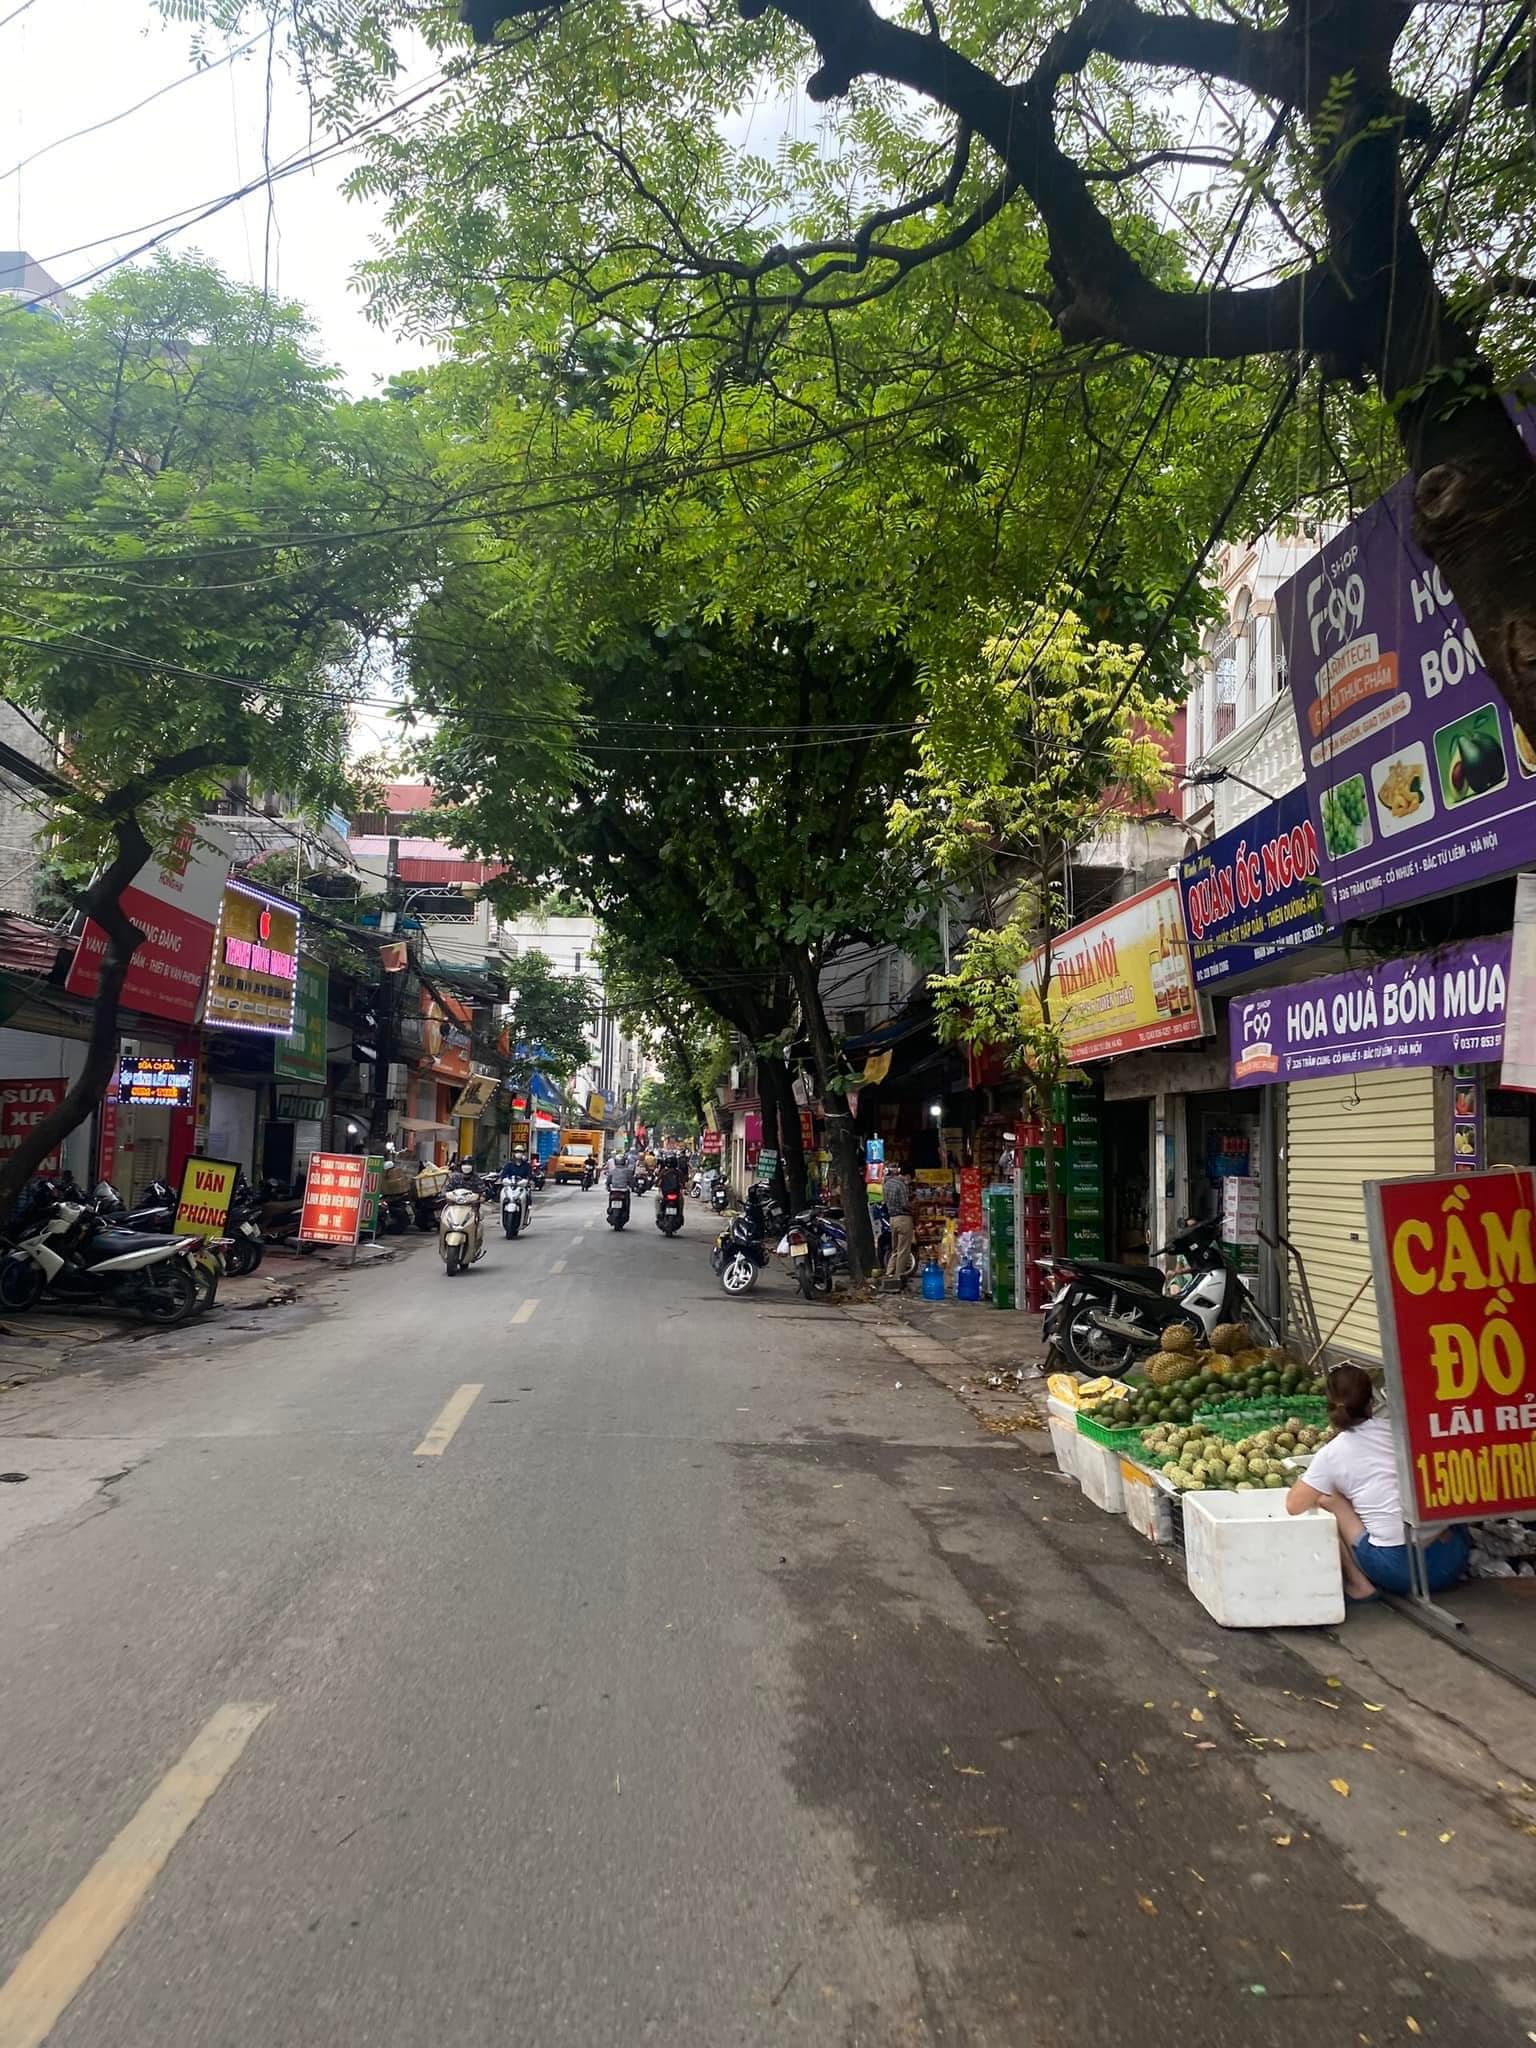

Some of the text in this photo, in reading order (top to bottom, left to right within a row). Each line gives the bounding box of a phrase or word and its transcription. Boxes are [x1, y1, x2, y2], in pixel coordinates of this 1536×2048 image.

[1330, 545, 1358, 579] SHOP
[1307, 573, 1365, 656] F99
[1410, 565, 1454, 624] HO
[1470, 838, 1482, 853] HÀ
[1482, 831, 1498, 851] NỘI
[1188, 819, 1320, 940] QUÁN ỐC NGON
[1057, 930, 1121, 998] BIA HÀ NỘI
[1287, 954, 1506, 1043] HOA QUẢ BỐN MÙA
[1243, 1004, 1271, 1041] F99
[1460, 1036, 1480, 1049] 0377
[10, 1111, 44, 1126] XE
[280, 1099, 325, 1118] PHOTO
[195, 1169, 225, 1193] VĂN
[176, 1200, 228, 1228] PHÒNG
[1392, 1184, 1536, 1296] CẦM
[1428, 1287, 1526, 1401] ĐỒ
[1428, 1392, 1536, 1438] LÃI RẺ
